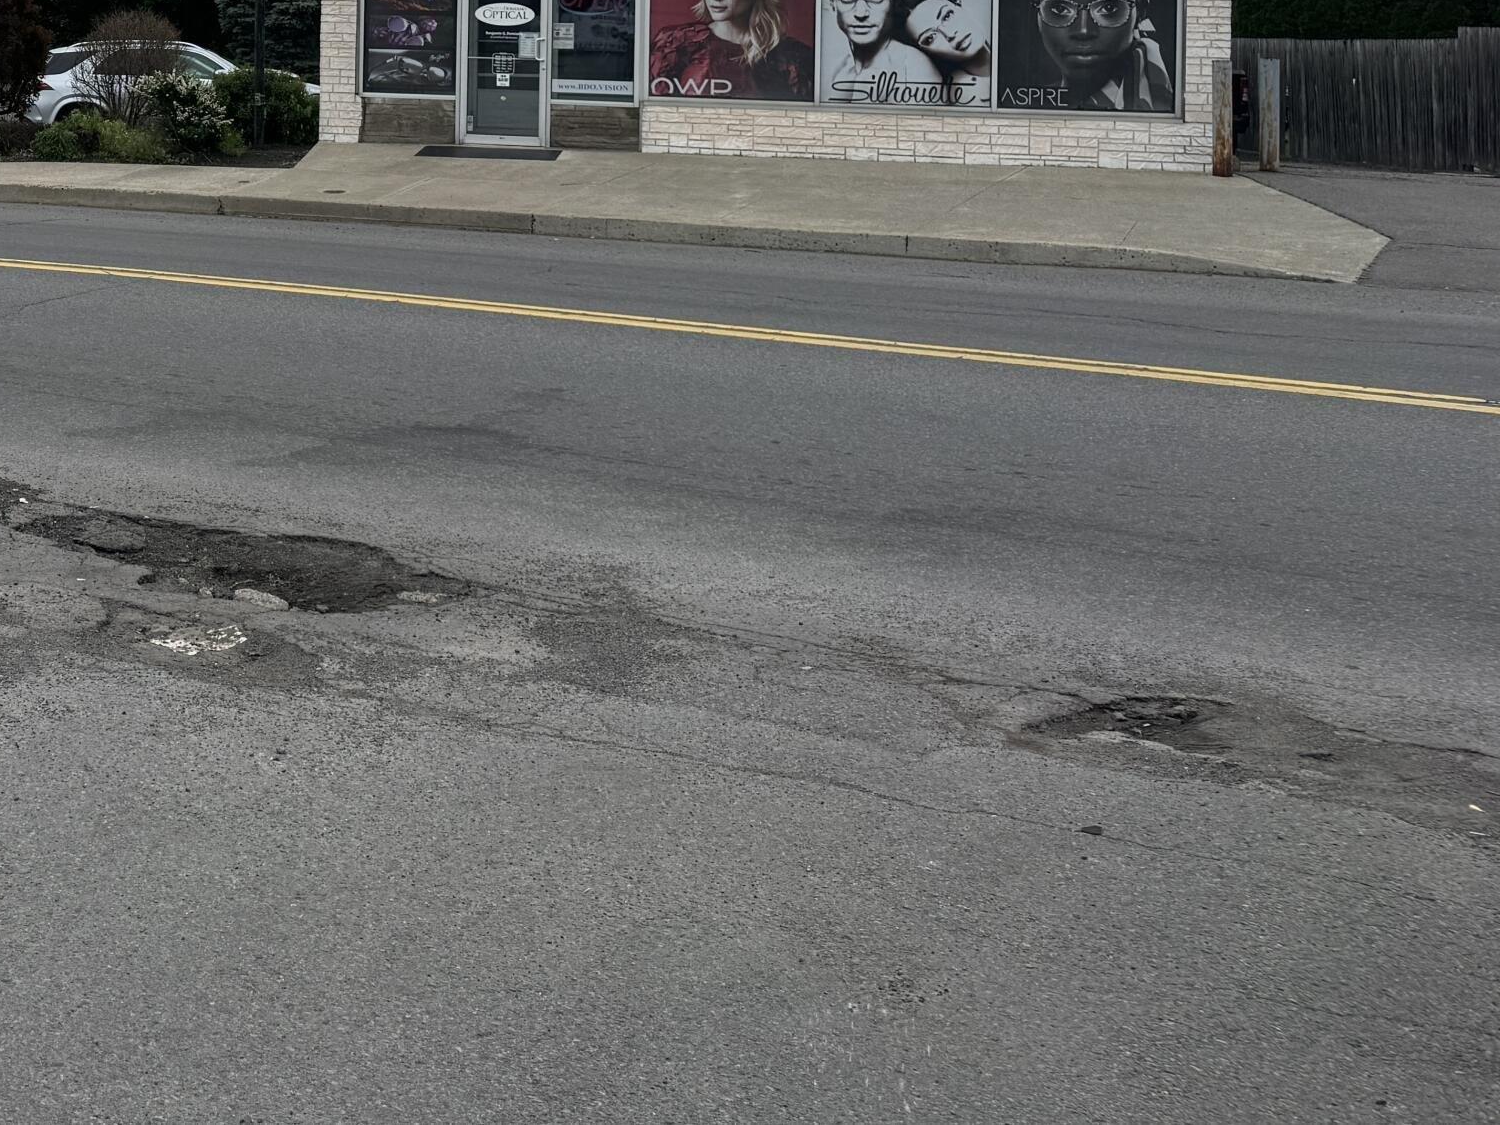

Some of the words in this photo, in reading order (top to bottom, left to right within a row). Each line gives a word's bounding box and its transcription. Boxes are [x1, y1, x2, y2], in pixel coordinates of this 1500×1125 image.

[482, 8, 529, 20] OPTICAL
[650, 77, 733, 96] OWP
[828, 71, 977, 105] Silhouette
[1001, 87, 1069, 107] ASPIRE
